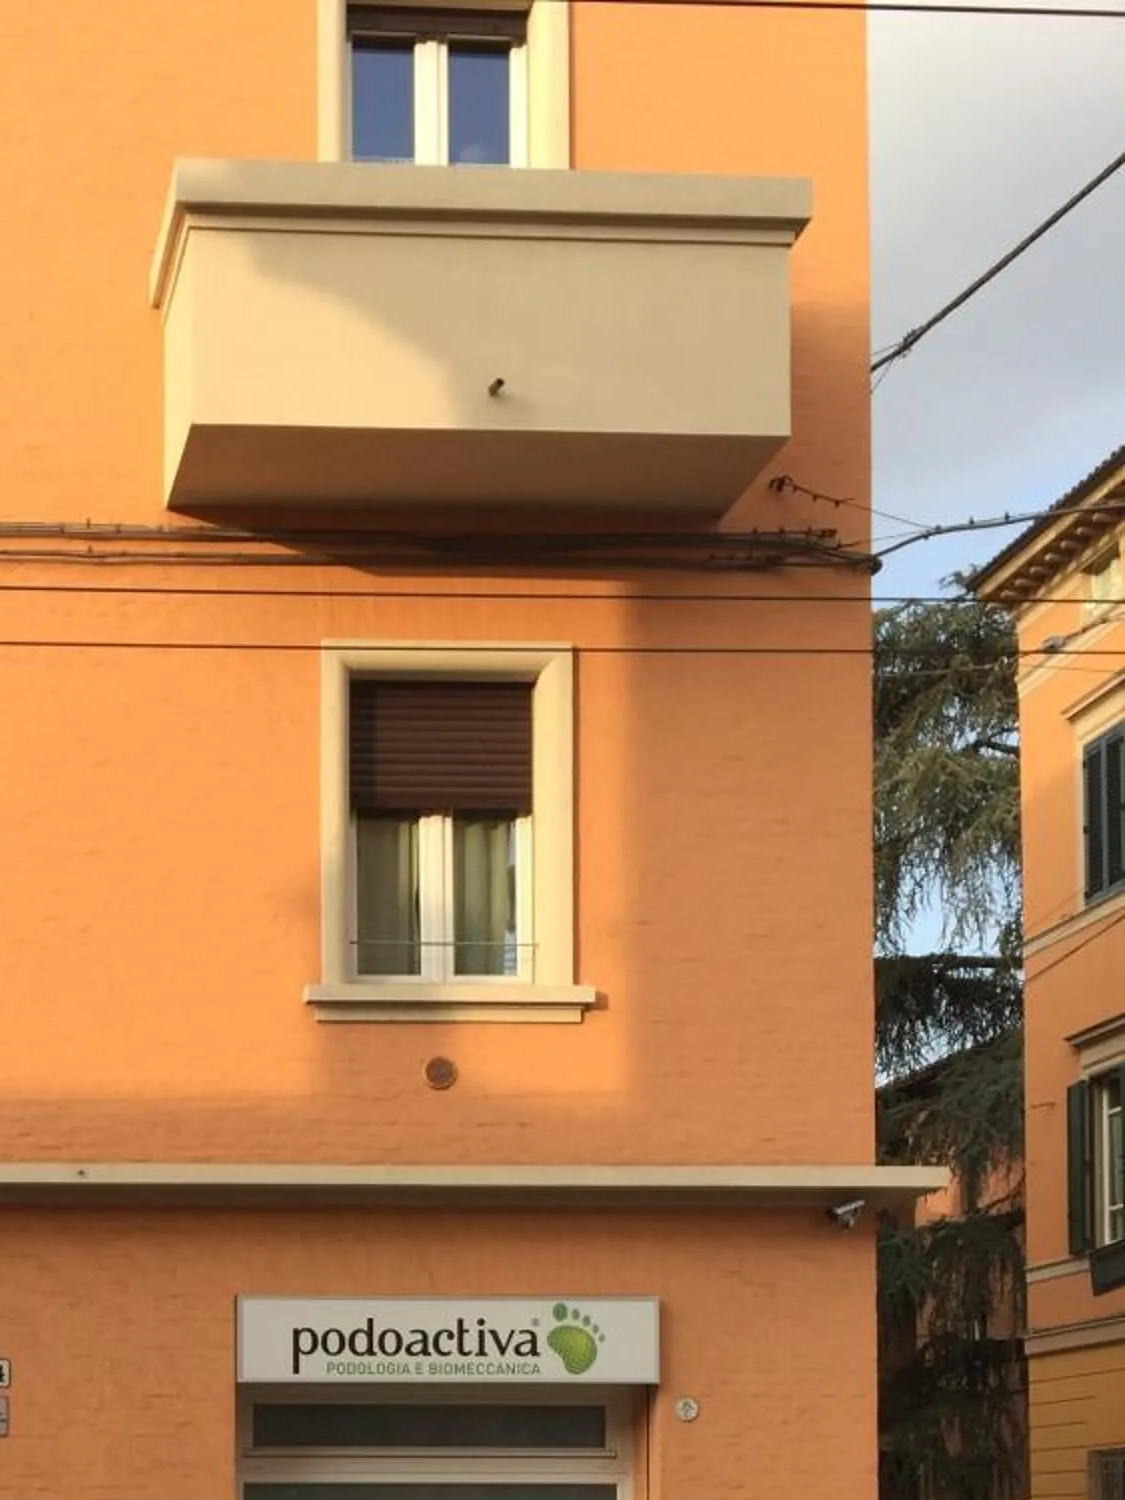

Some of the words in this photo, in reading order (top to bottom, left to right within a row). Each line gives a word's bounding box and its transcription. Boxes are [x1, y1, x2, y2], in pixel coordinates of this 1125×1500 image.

[292, 1317, 541, 1375] podoactiva
[326, 1362, 412, 1375] PODOLOGIA
[415, 1362, 424, 1375] E
[428, 1362, 541, 1375] BIOMECCANICA
